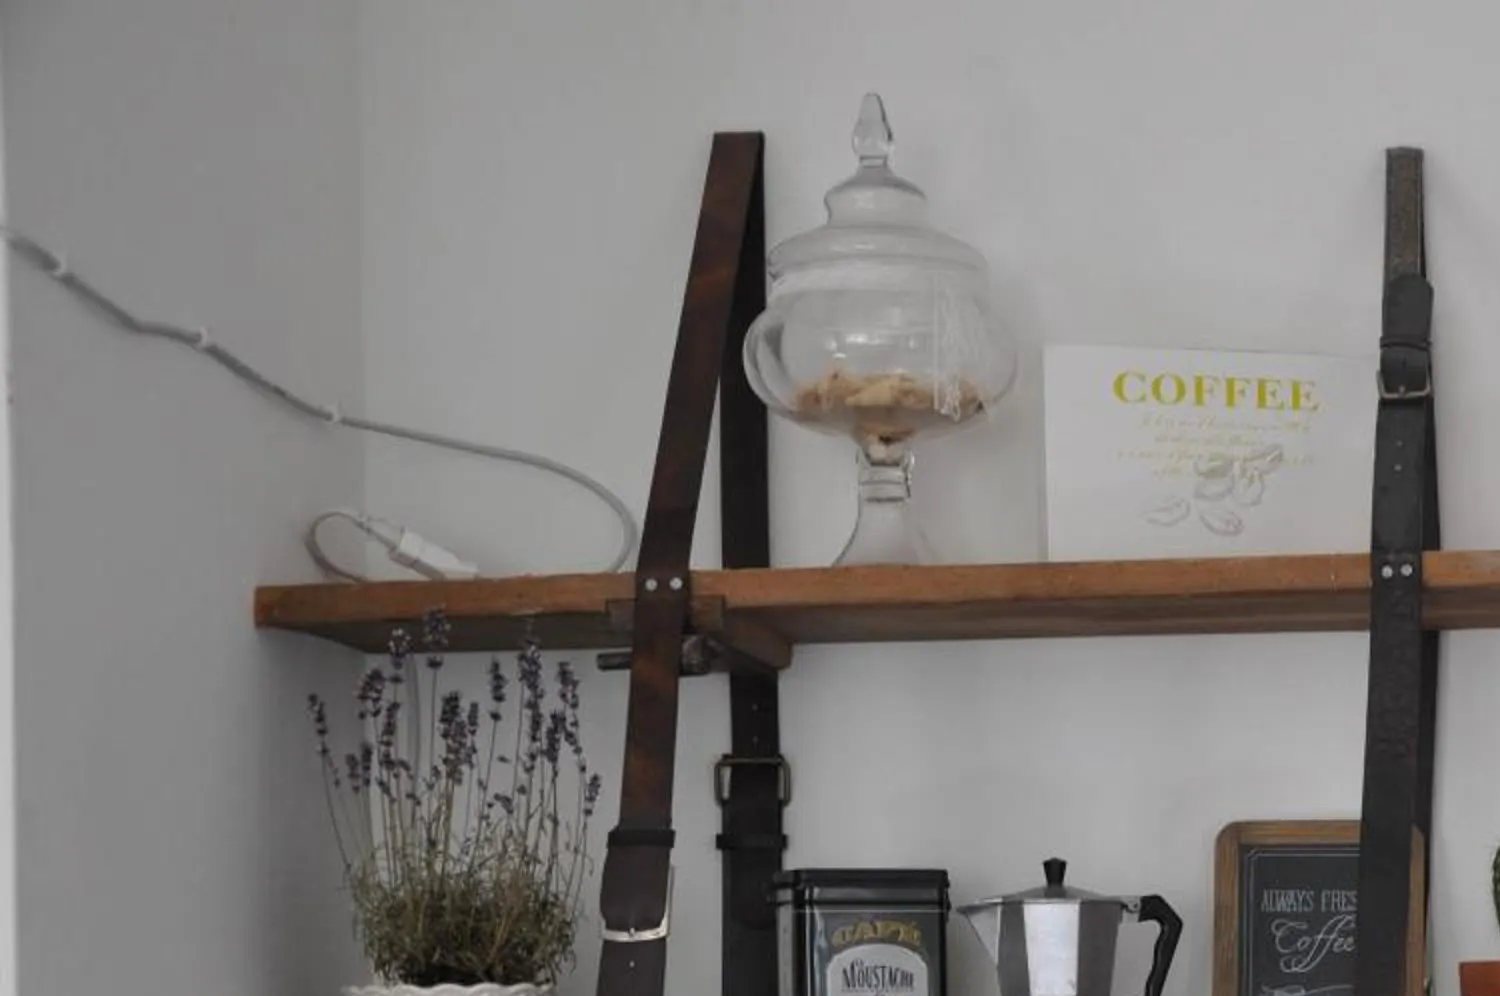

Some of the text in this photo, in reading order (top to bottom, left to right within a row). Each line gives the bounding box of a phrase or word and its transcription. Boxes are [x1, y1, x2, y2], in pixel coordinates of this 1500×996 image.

[1112, 370, 1321, 414] COFFEE
[1261, 888, 1358, 913] ALWAYS FRES
[1271, 913, 1358, 973] Coffee
[842, 958, 915, 989] MOUSTACHE
